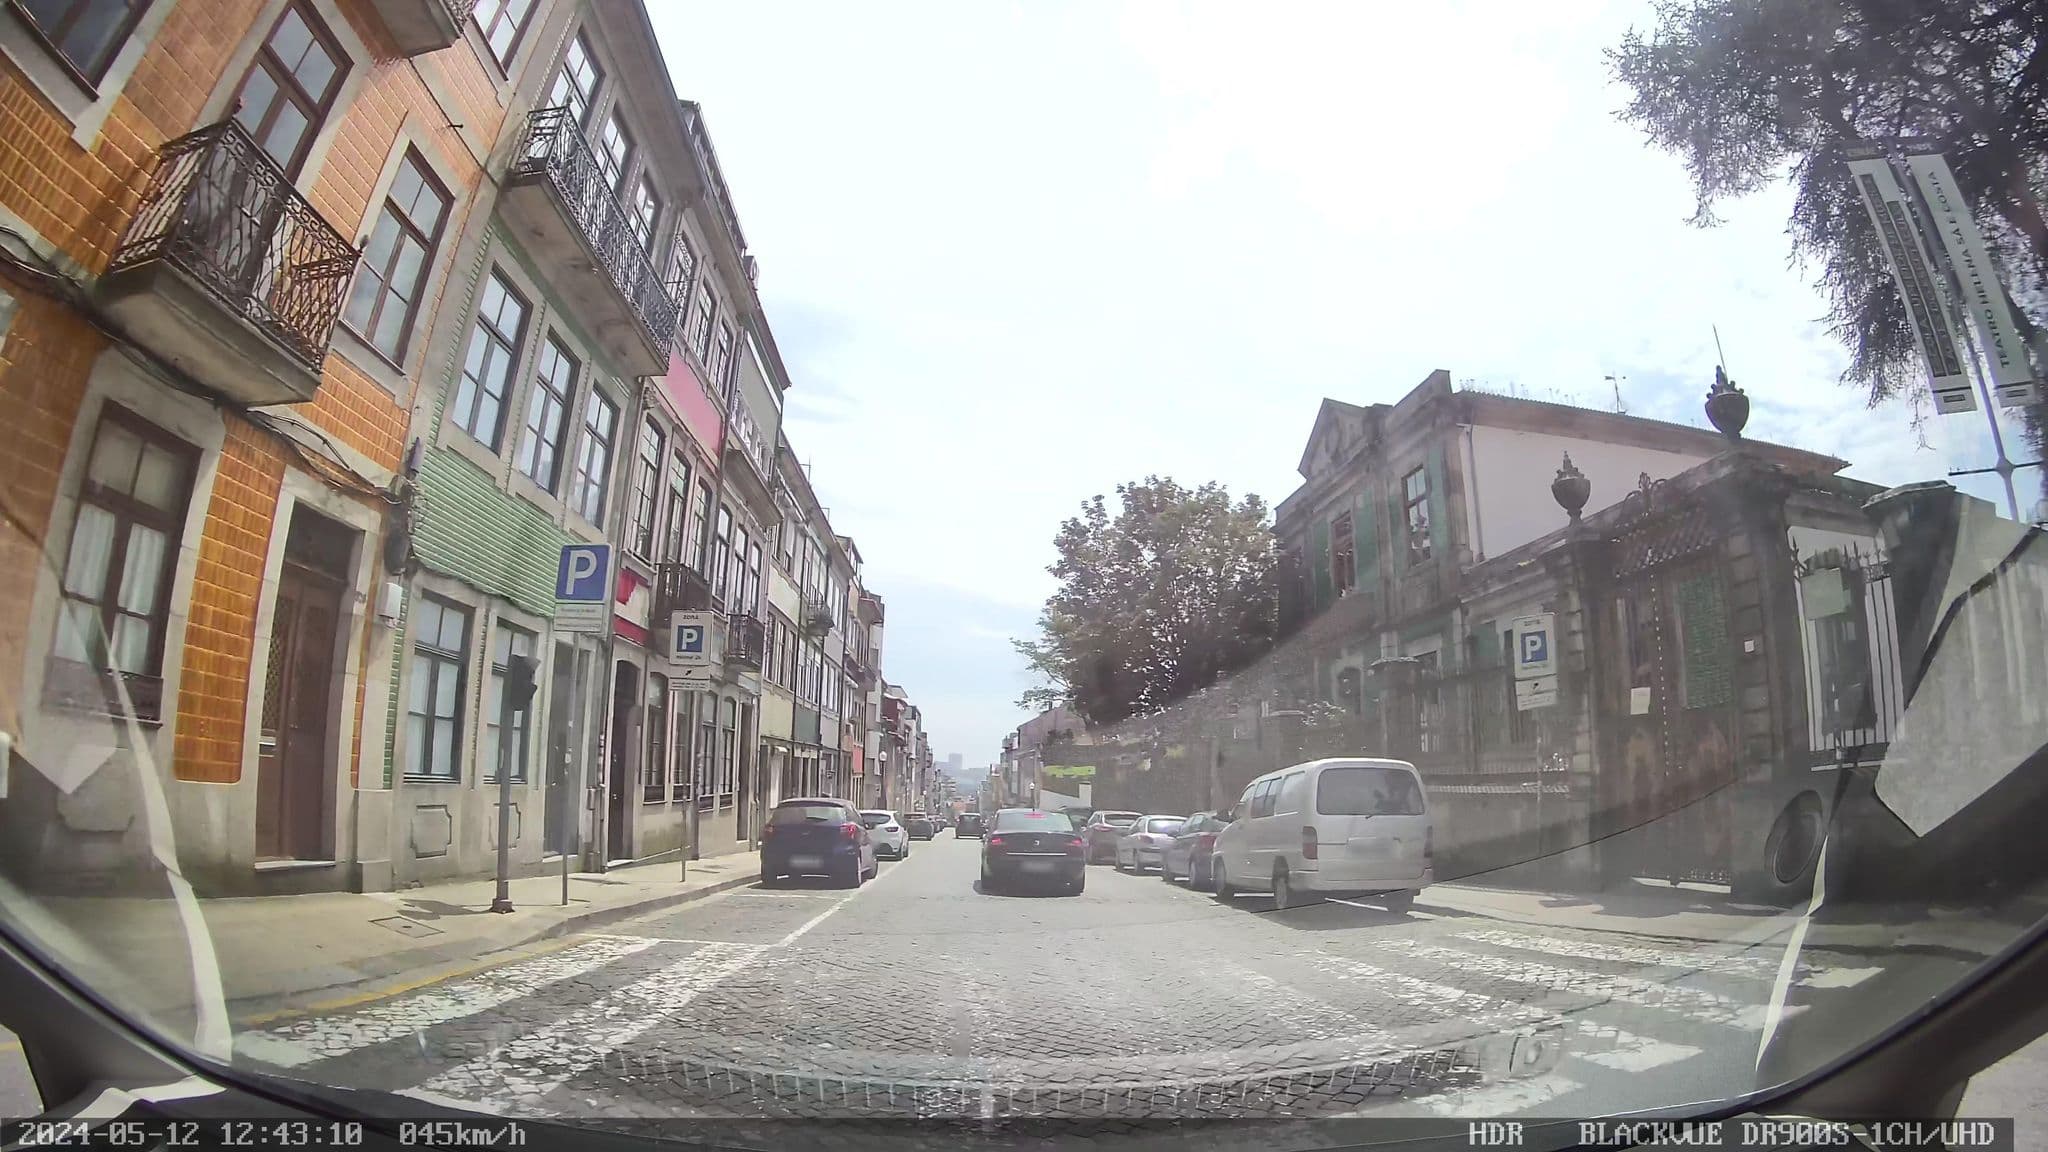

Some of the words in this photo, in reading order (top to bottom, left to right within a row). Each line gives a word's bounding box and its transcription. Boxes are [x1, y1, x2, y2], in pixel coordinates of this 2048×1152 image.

[1962, 248, 1990, 305] HELENA
[1984, 308, 2010, 369] TEATRO
[565, 549, 597, 595] P
[681, 628, 698, 650] P
[1525, 635, 1542, 661] P
